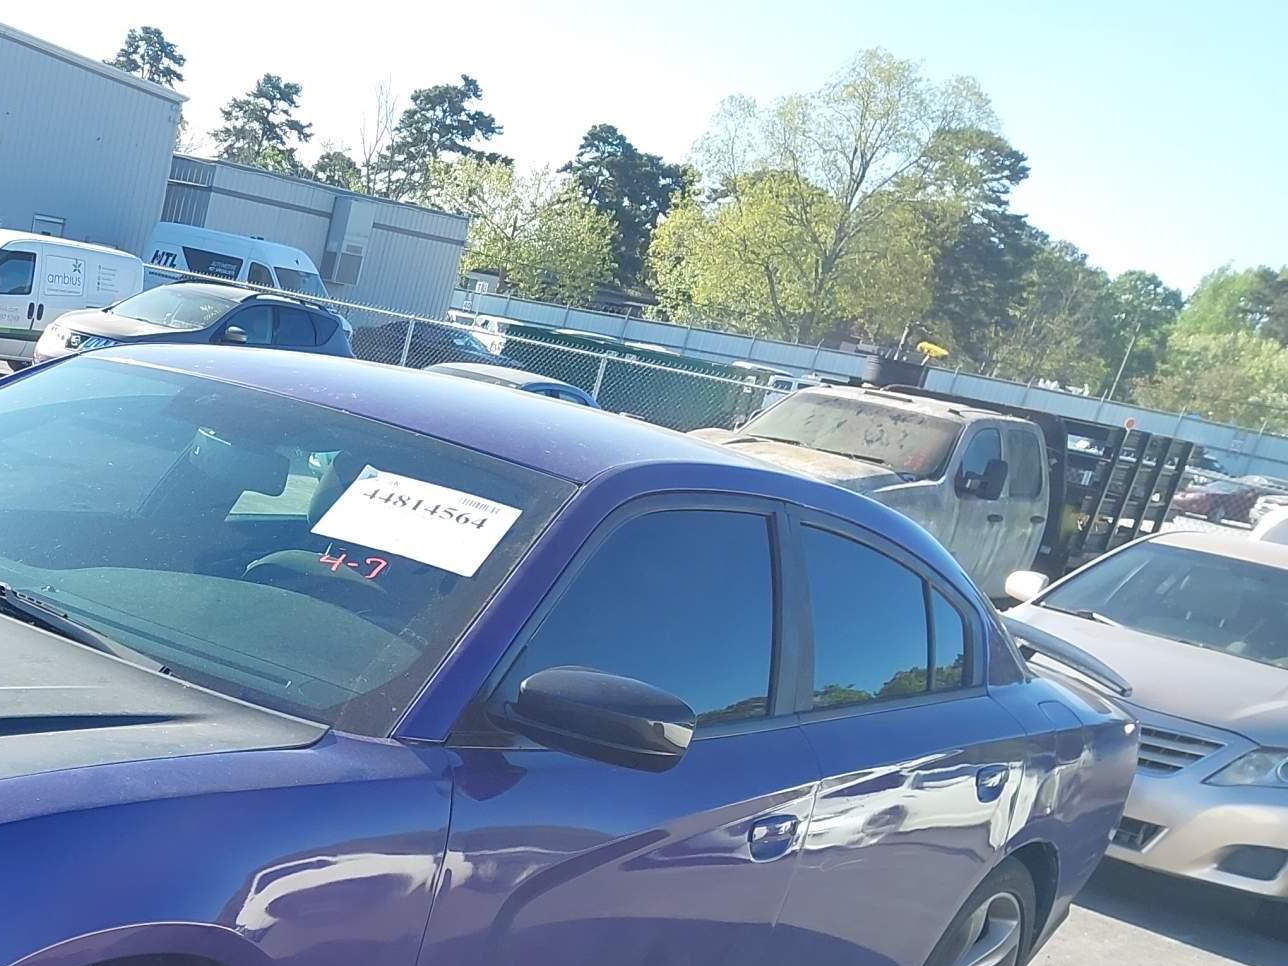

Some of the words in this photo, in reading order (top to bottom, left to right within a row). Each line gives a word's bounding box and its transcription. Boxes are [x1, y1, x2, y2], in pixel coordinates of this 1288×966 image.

[47, 271, 82, 287] ambius
[363, 488, 488, 530] 44814564
[319, 552, 388, 580] 4-7
